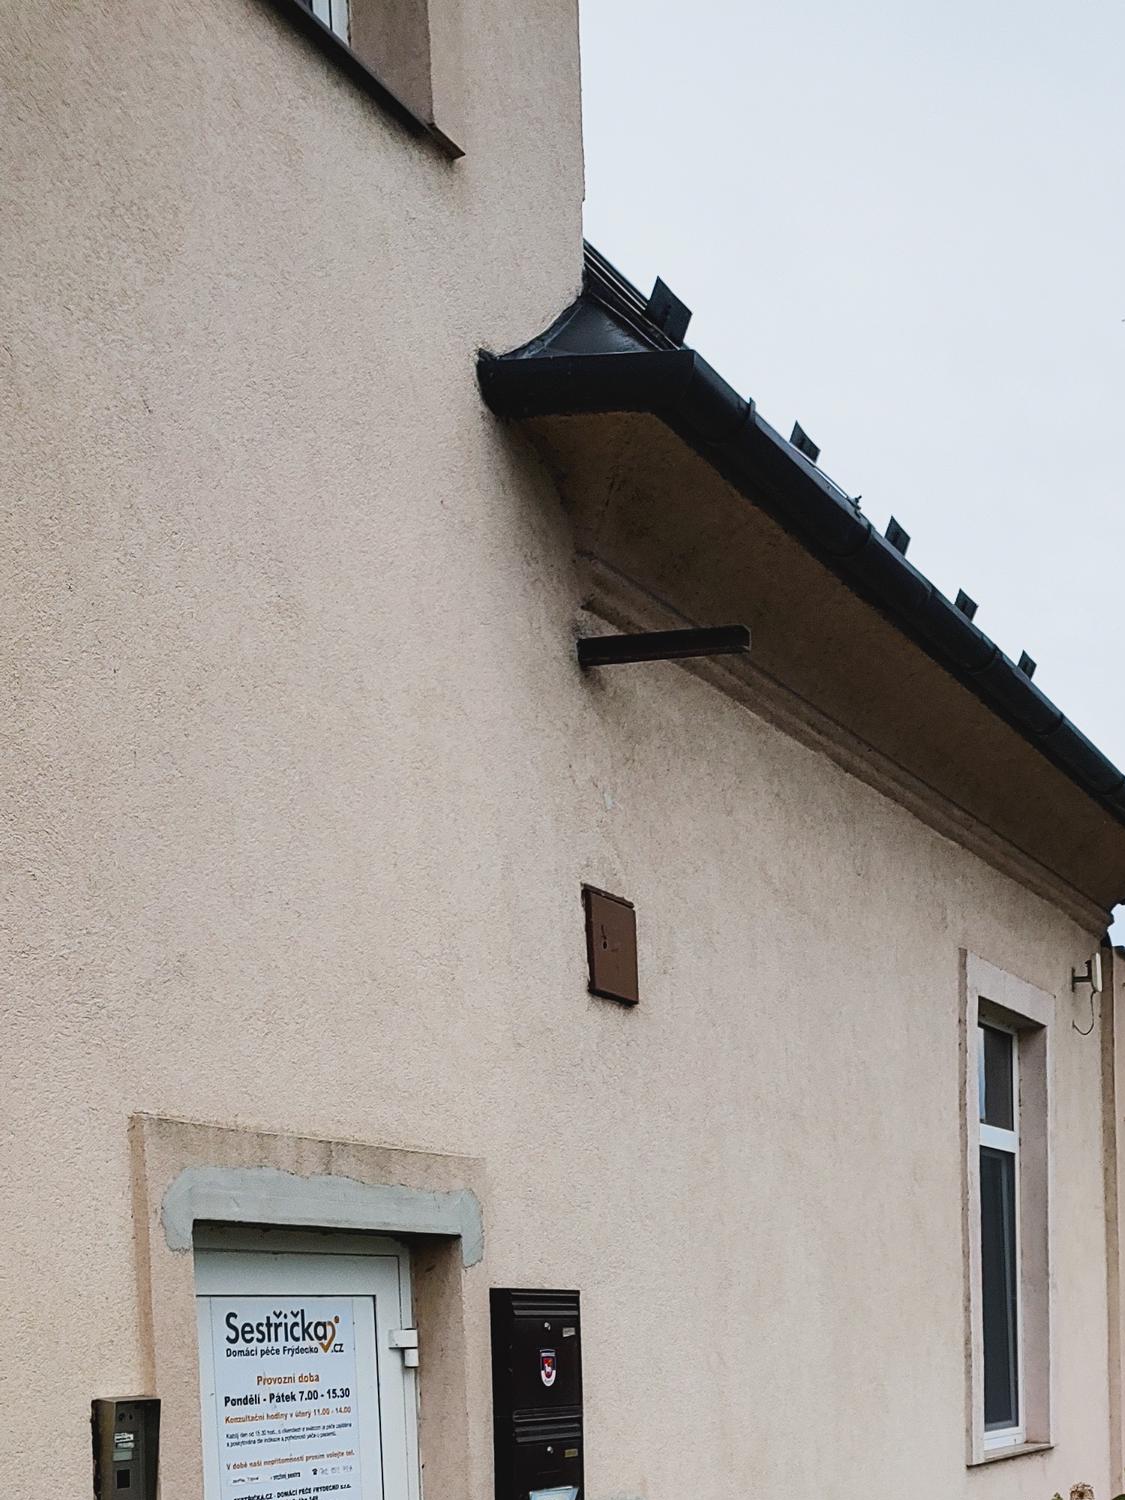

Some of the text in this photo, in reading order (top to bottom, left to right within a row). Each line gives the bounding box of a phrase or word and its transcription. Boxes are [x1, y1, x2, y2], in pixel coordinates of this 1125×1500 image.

[226, 1309, 328, 1344] Sestřička
[283, 1345, 319, 1357] Frýdecko
[298, 1373, 320, 1383] doba
[224, 1393, 261, 1407] Pondělí
[269, 1391, 297, 1404] Pátek
[299, 1390, 319, 1402] 7.00
[327, 1388, 351, 1400] 15.30
